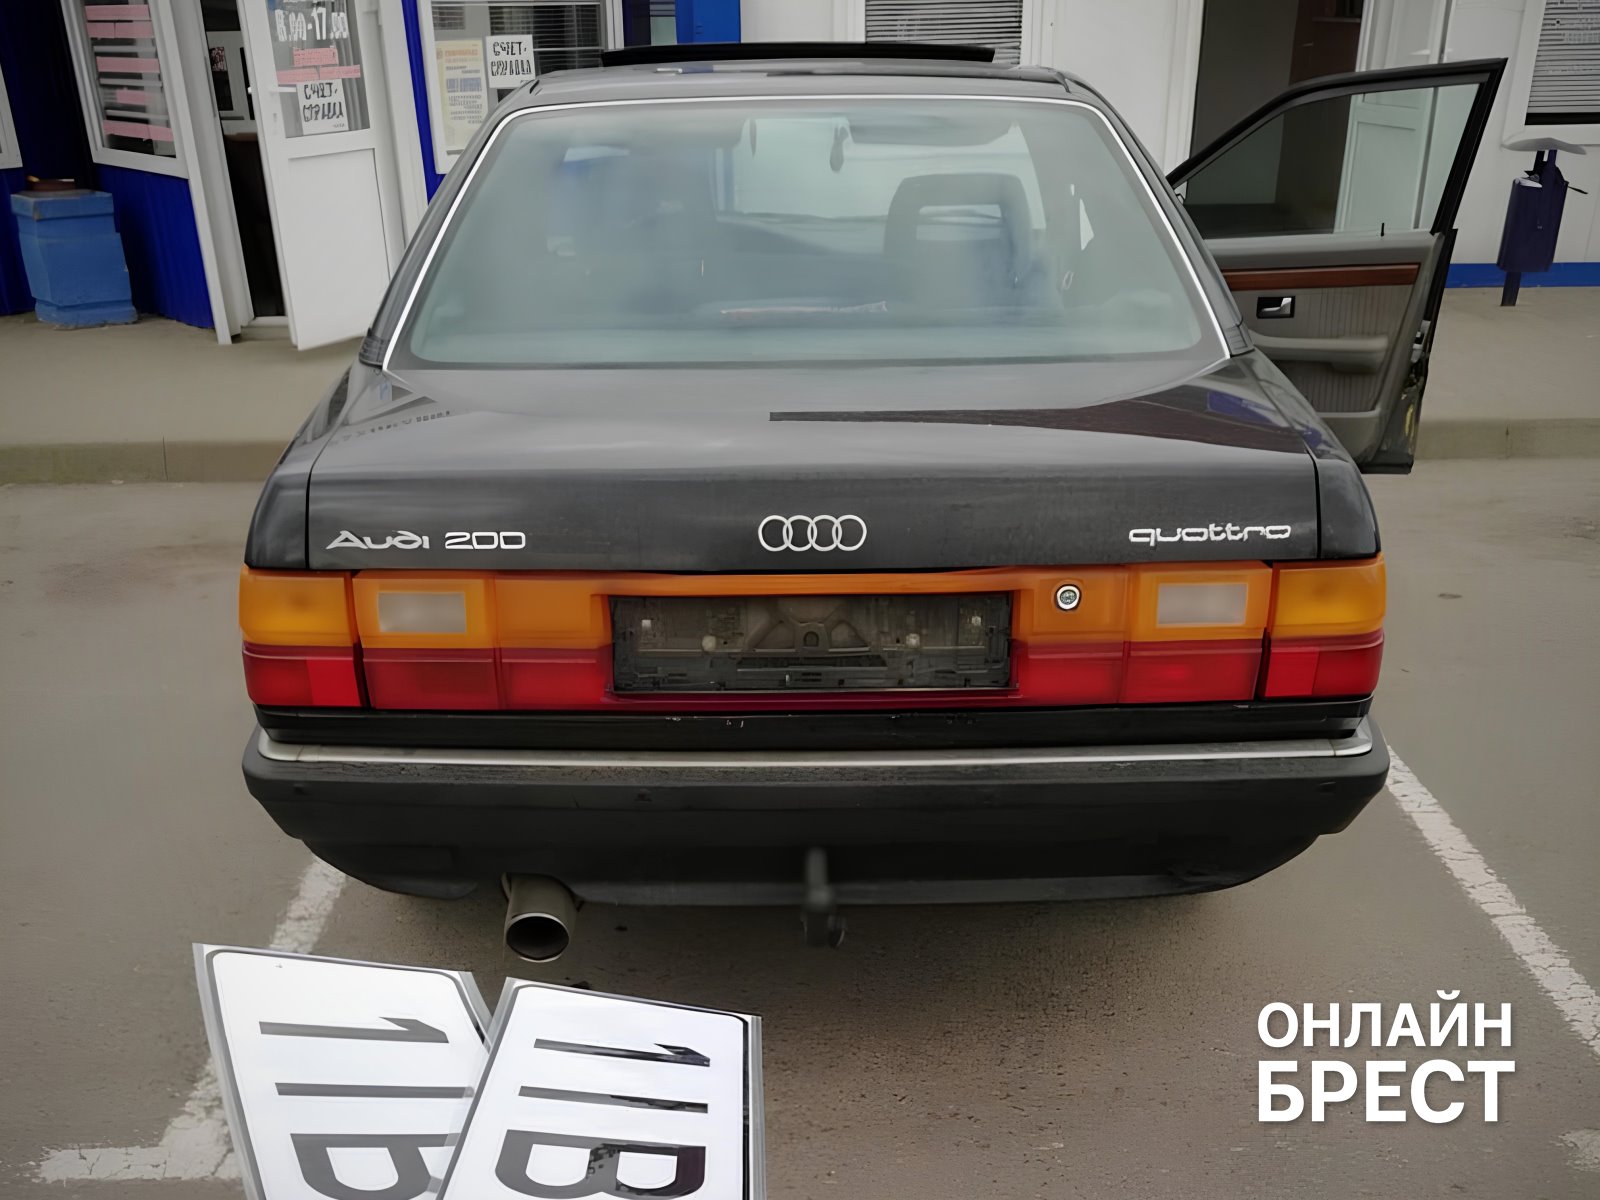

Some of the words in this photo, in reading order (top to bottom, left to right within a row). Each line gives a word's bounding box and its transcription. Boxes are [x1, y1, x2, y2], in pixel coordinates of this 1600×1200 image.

[325, 530, 430, 550] Audi
[444, 531, 526, 550] 200
[1128, 523, 1292, 547] quattro
